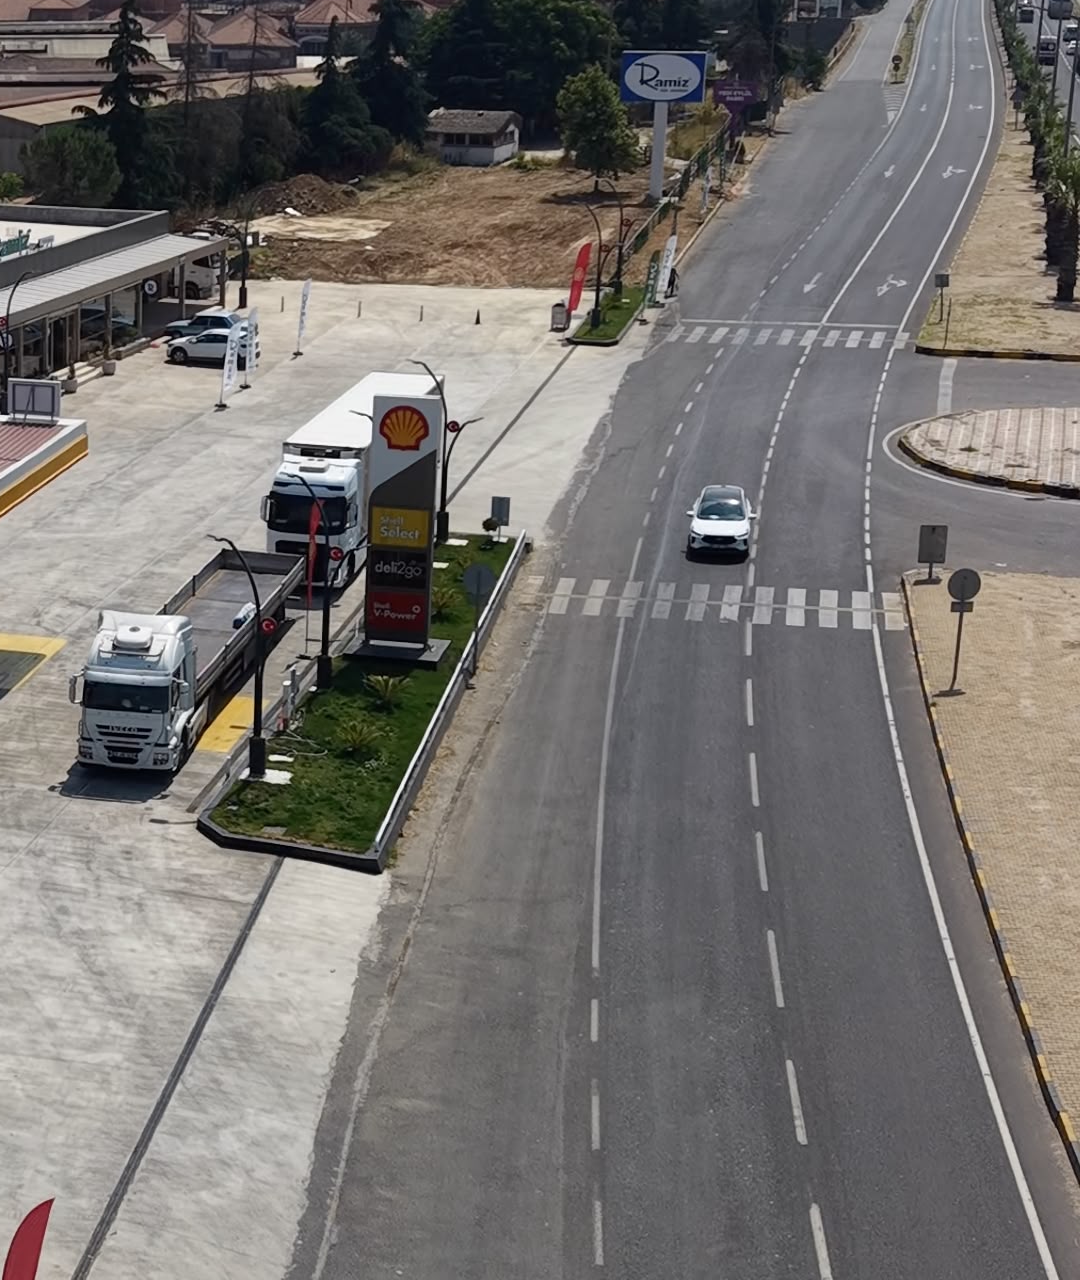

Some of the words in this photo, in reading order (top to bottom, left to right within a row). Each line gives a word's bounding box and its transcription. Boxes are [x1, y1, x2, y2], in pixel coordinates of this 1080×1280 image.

[634, 62, 689, 91] Ramiz
[380, 526, 420, 539] Select
[375, 561, 422, 578] deli2go
[373, 608, 417, 620] V-Power
[110, 725, 138, 733] IVECO
